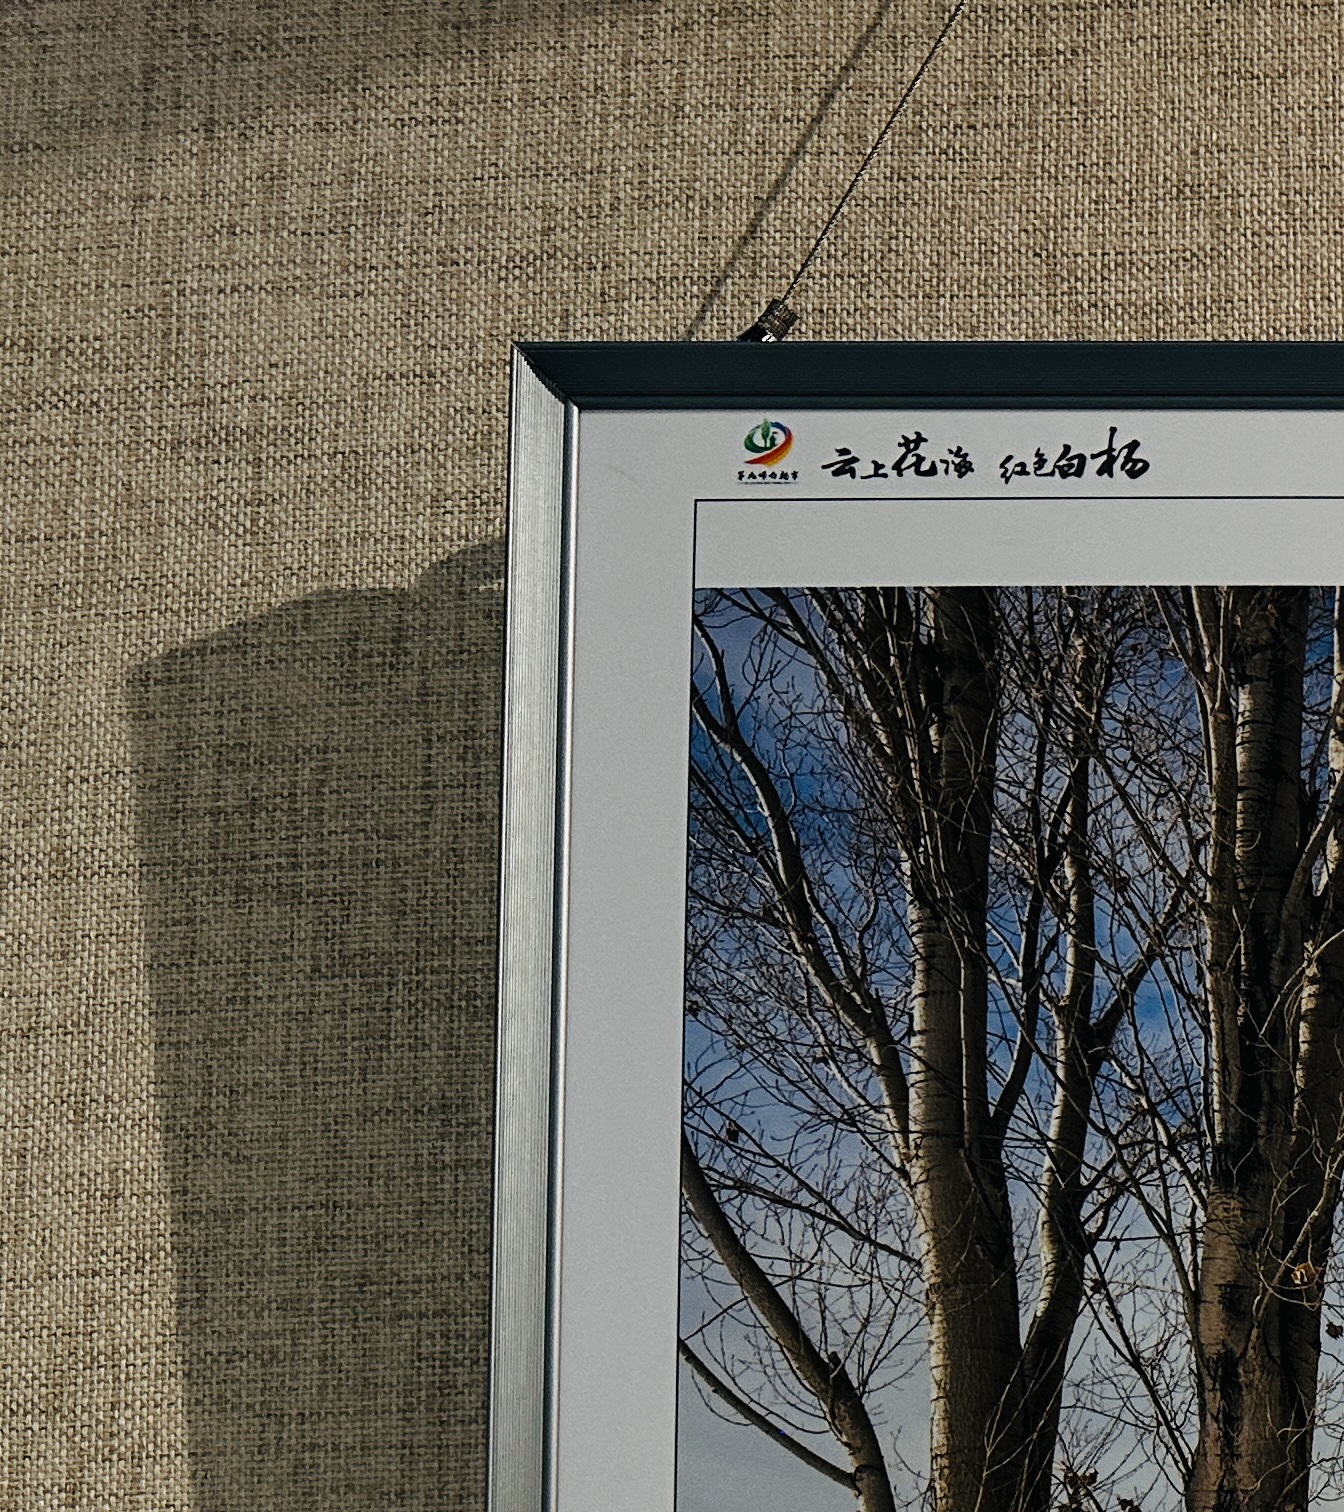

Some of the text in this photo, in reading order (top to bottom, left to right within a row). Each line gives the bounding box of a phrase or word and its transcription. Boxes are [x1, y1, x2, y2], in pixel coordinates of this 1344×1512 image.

[821, 426, 1150, 485] 云上花海 红色白杨
